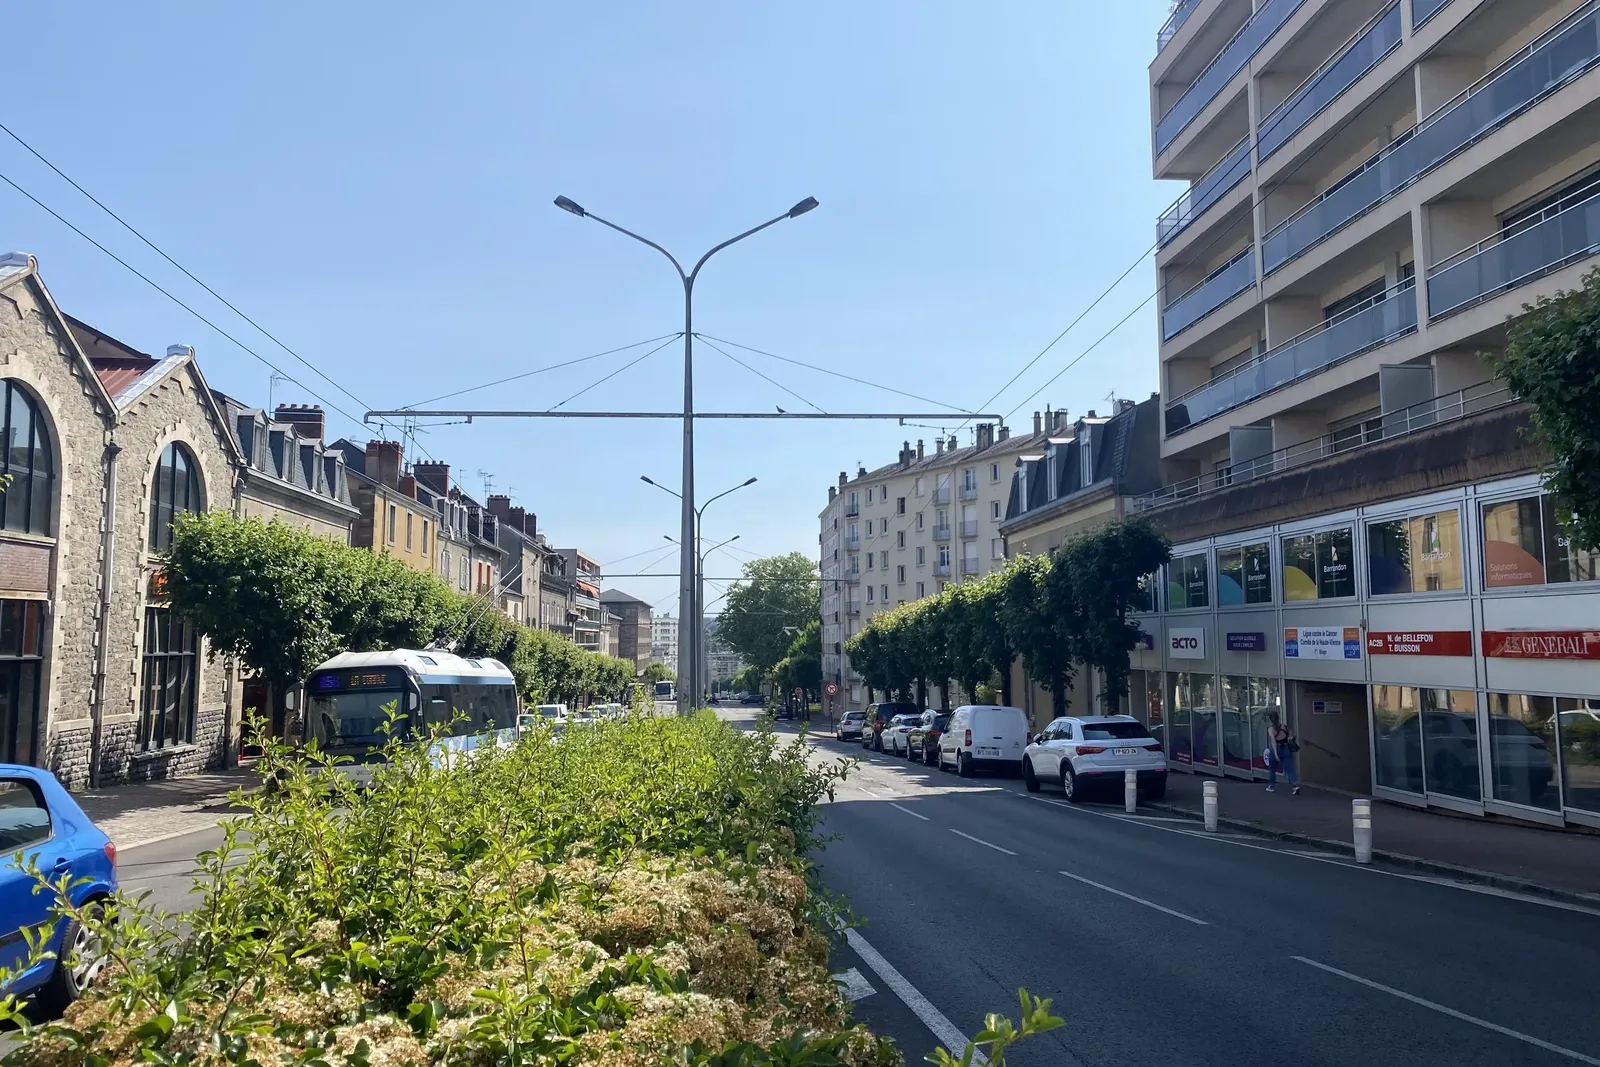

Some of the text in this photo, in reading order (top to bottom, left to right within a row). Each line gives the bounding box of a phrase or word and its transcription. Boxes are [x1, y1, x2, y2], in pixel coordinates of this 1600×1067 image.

[1421, 551, 1451, 561] Barrandon
[1323, 564, 1347, 573] Barrandon
[1490, 563, 1518, 572] Solutions
[1402, 634, 1433, 642] BELLEFON
[1394, 644, 1420, 652] BUISSON
[1522, 636, 1589, 654] GENERALI
